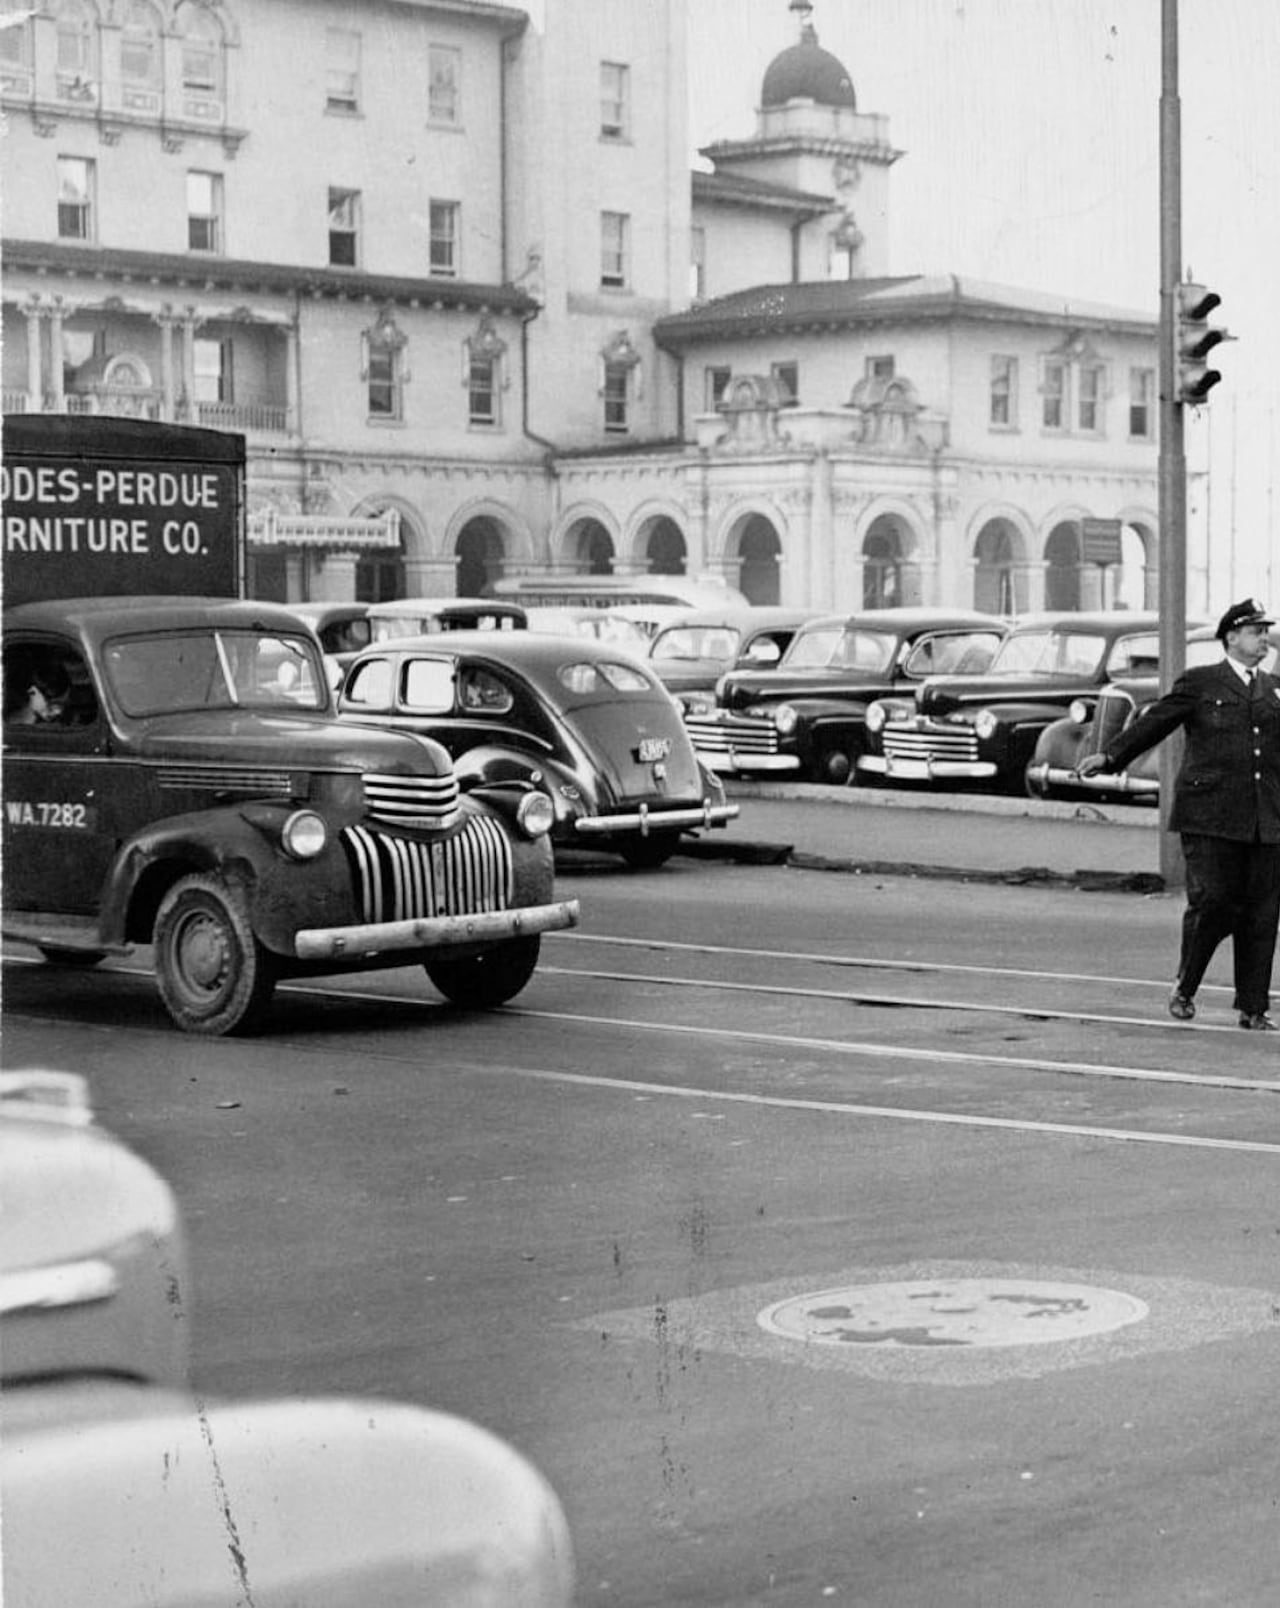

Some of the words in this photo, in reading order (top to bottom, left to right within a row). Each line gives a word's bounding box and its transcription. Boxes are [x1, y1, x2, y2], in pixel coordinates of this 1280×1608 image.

[2, 516, 149, 553] RNITURE
[163, 520, 208, 555] CO.
[6, 802, 87, 828] WA.7282
